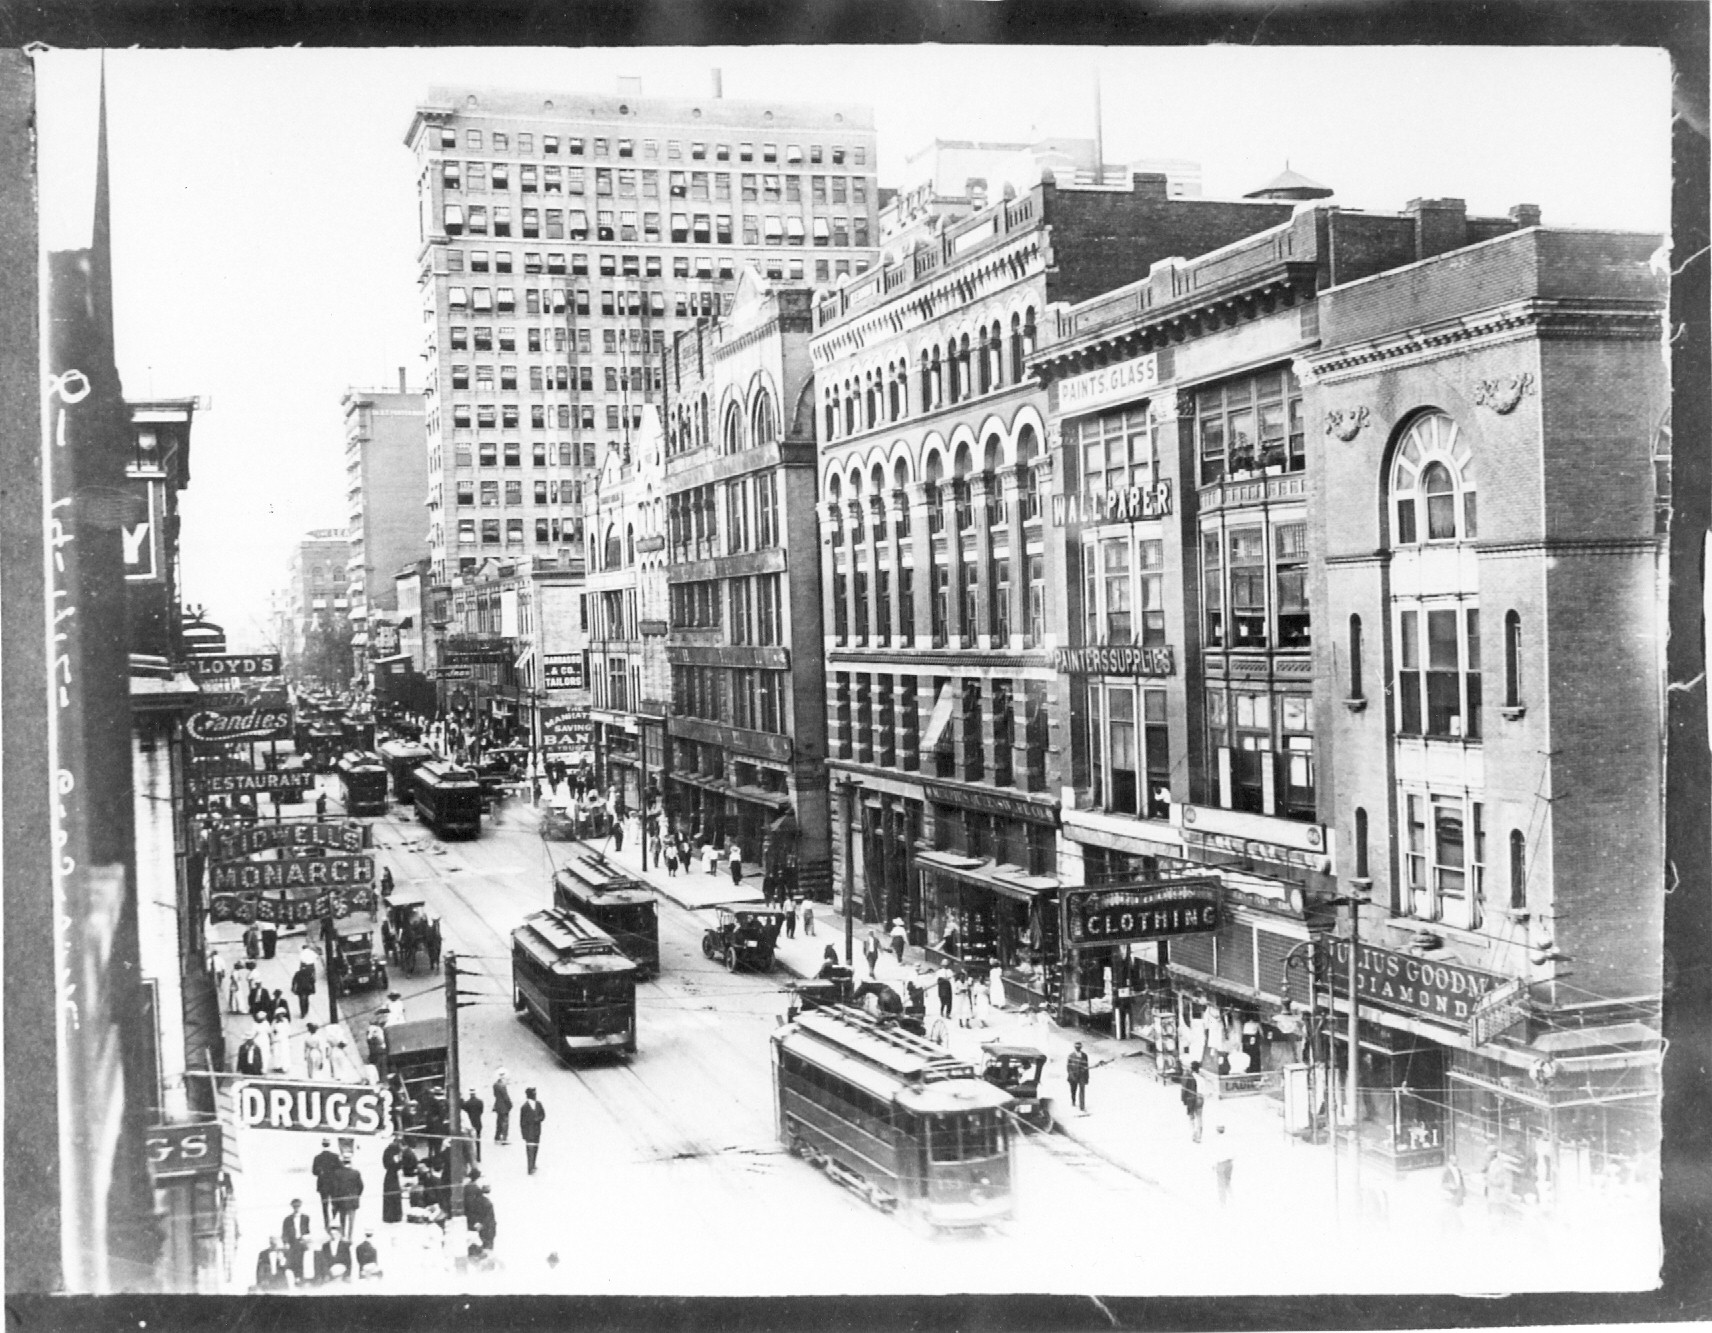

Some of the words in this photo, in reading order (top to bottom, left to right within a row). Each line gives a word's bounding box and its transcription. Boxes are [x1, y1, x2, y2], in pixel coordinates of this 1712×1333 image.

[1054, 494, 1102, 526] WALL
[1106, 482, 1169, 520] PAPER
[186, 708, 288, 740] Candies
[543, 733, 594, 746] BAN
[554, 724, 594, 732] SAVING
[214, 859, 371, 889] MONARCH
[1087, 905, 1215, 934] CLOTHING
[1357, 973, 1479, 1018] DIAMOND
[241, 1087, 379, 1131] DRUGS
